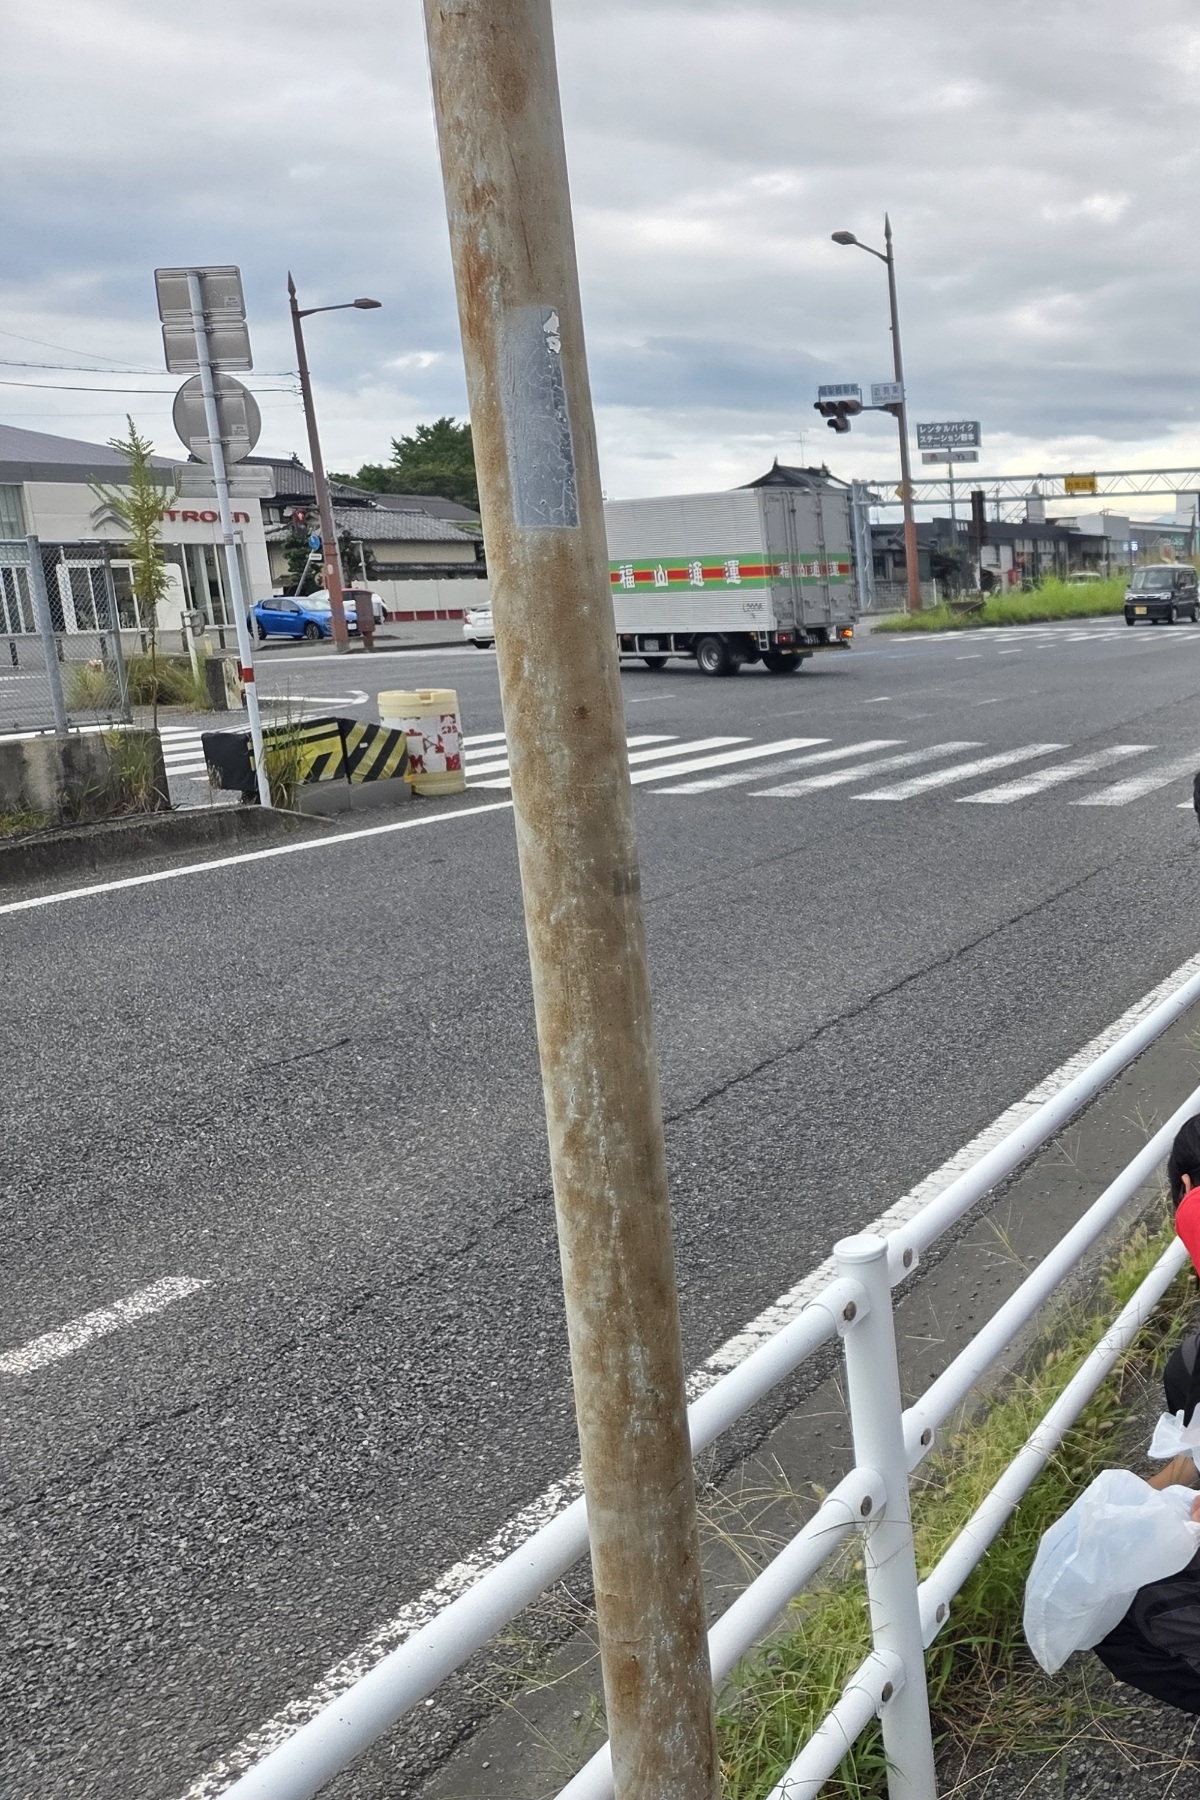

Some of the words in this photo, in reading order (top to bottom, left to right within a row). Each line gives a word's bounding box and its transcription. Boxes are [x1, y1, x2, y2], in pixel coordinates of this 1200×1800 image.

[618, 559, 742, 589] 福山通運
[779, 560, 840, 578] 福山通運
